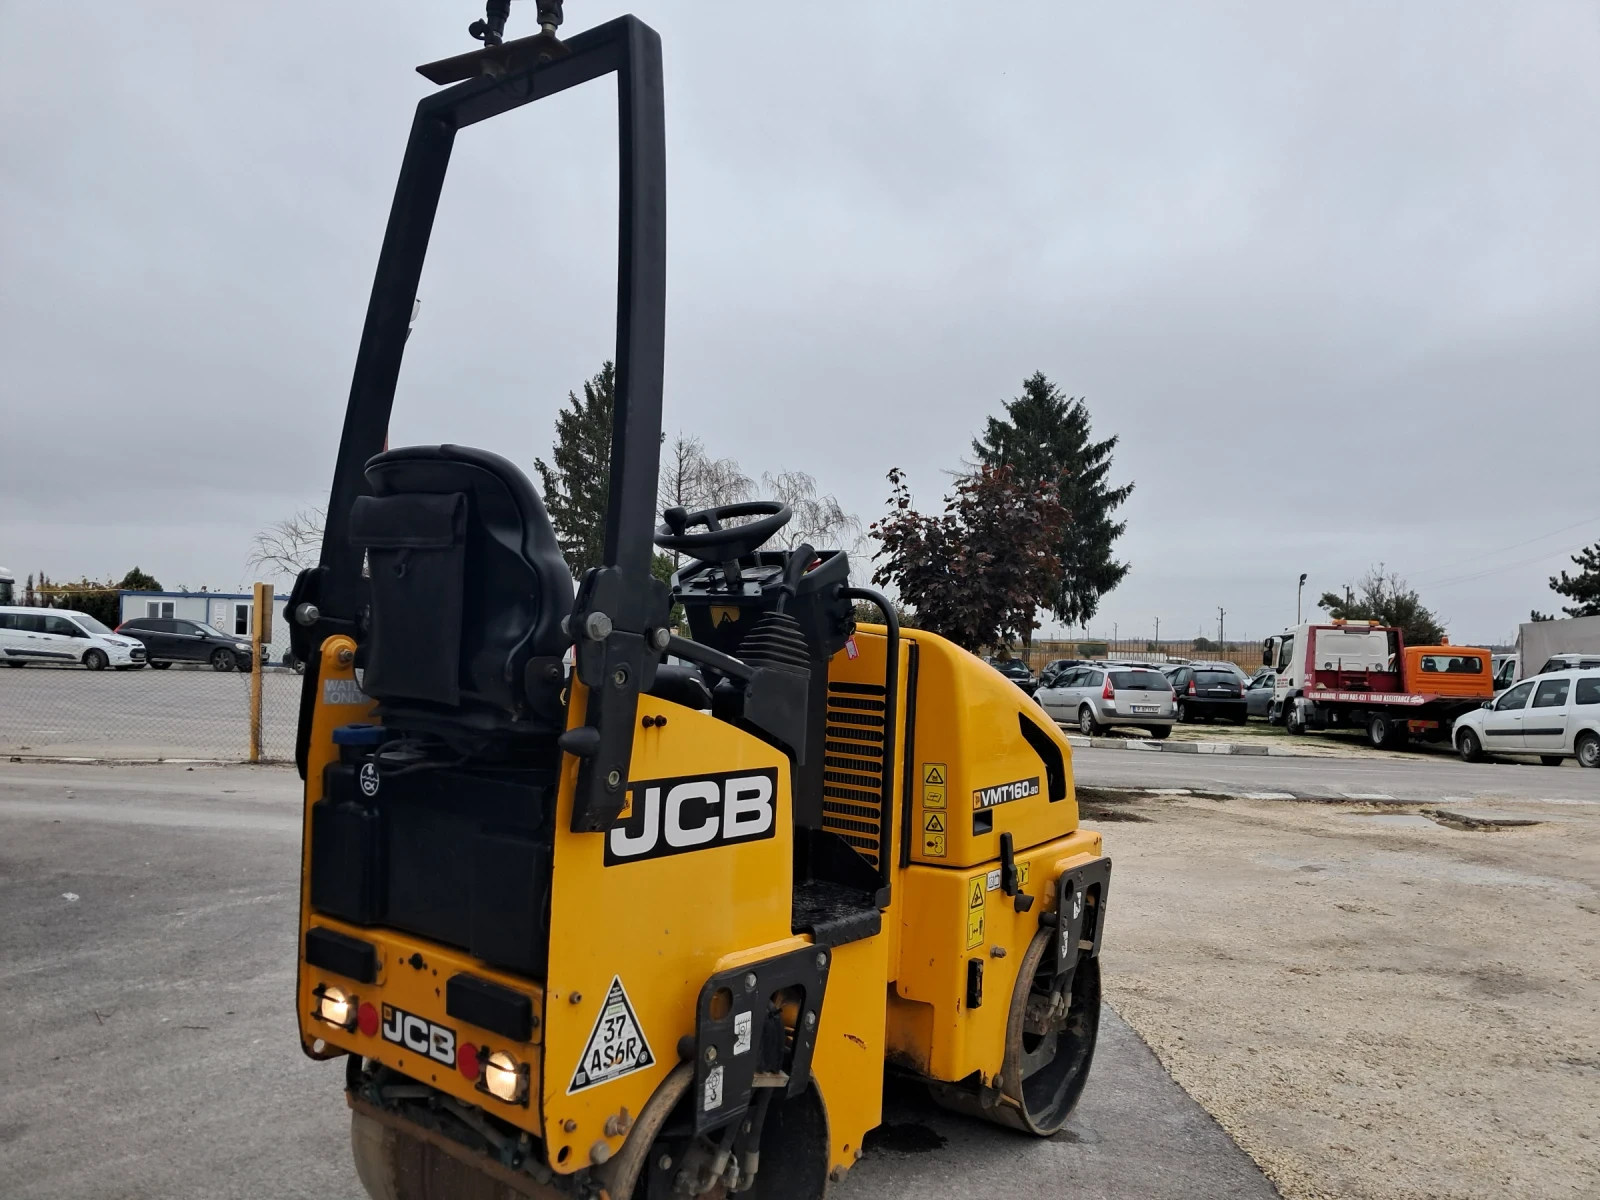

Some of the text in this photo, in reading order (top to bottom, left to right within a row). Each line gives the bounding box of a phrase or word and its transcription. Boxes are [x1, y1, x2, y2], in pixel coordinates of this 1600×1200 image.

[326, 680, 360, 691] WATE
[331, 692, 363, 703] ONLY
[610, 775, 773, 857] JCB
[383, 1010, 455, 1065] JCB
[603, 1014, 626, 1043] 37
[590, 1037, 636, 1074] AS6R
